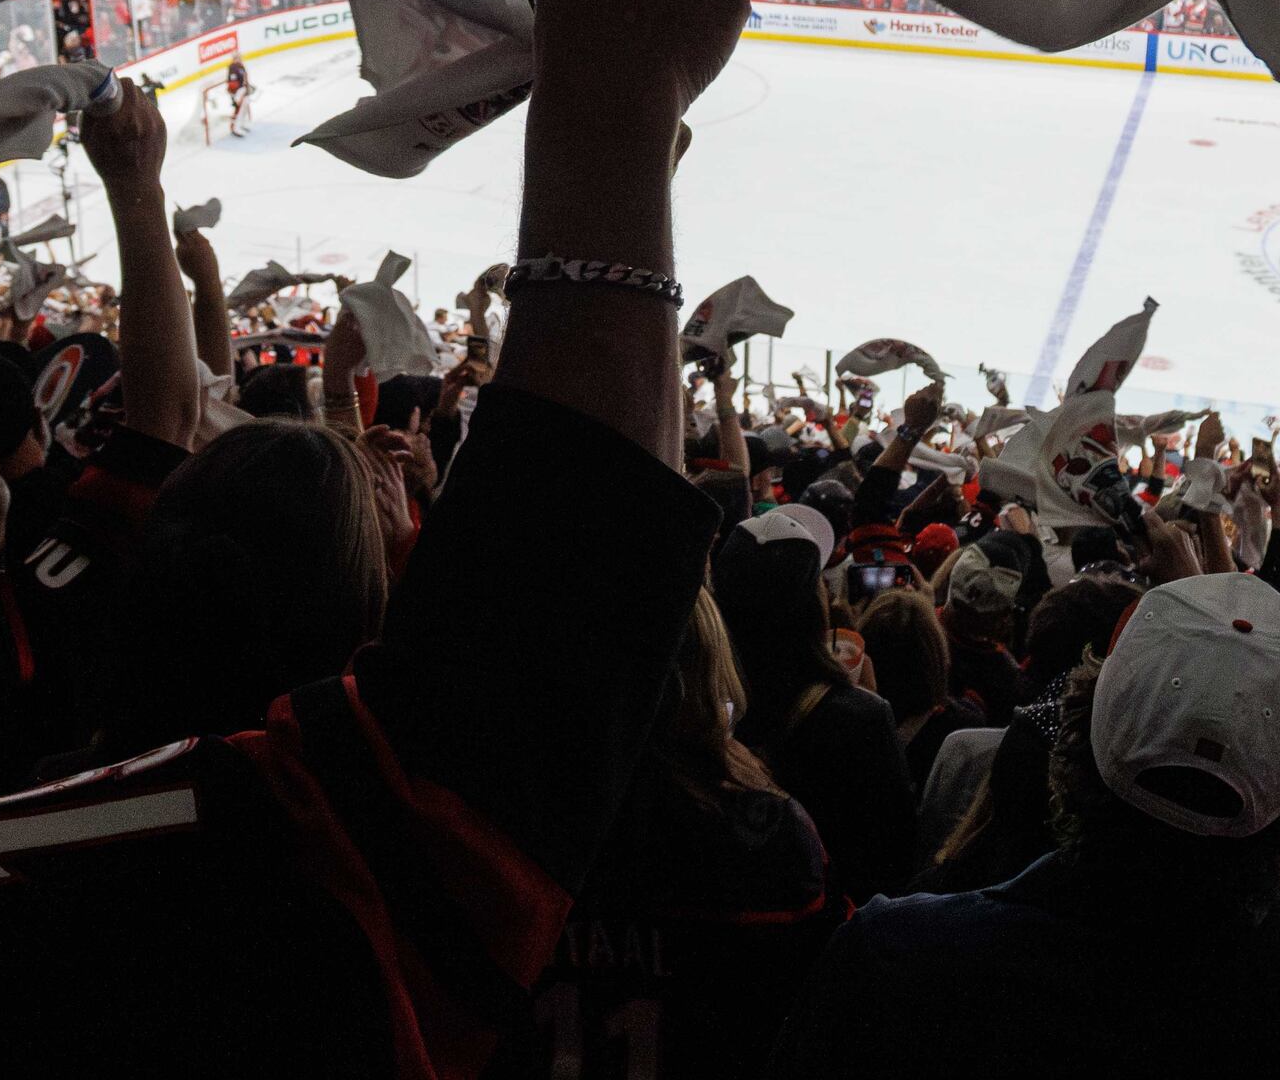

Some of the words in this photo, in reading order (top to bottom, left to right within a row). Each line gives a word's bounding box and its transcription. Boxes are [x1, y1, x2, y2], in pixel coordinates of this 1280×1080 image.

[889, 18, 932, 35] Harris
[935, 23, 980, 39] Teeter
[1166, 41, 1229, 66] UNC
